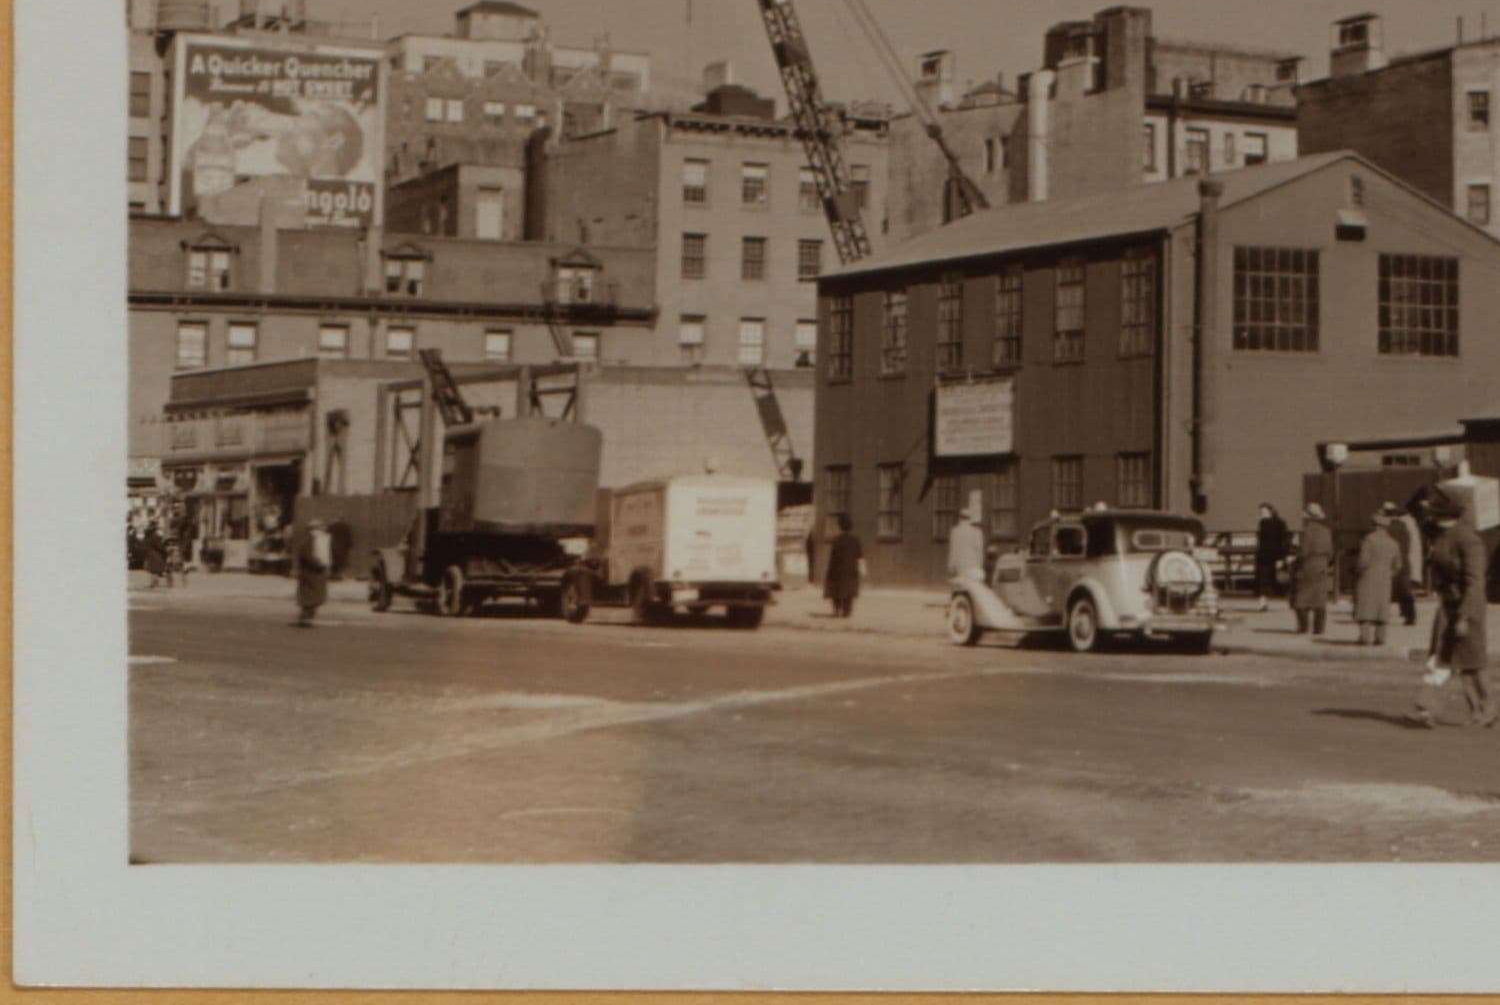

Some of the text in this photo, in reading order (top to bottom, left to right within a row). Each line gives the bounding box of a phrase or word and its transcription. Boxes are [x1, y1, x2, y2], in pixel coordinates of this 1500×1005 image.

[191, 54, 373, 79] A Quicker Quencher
